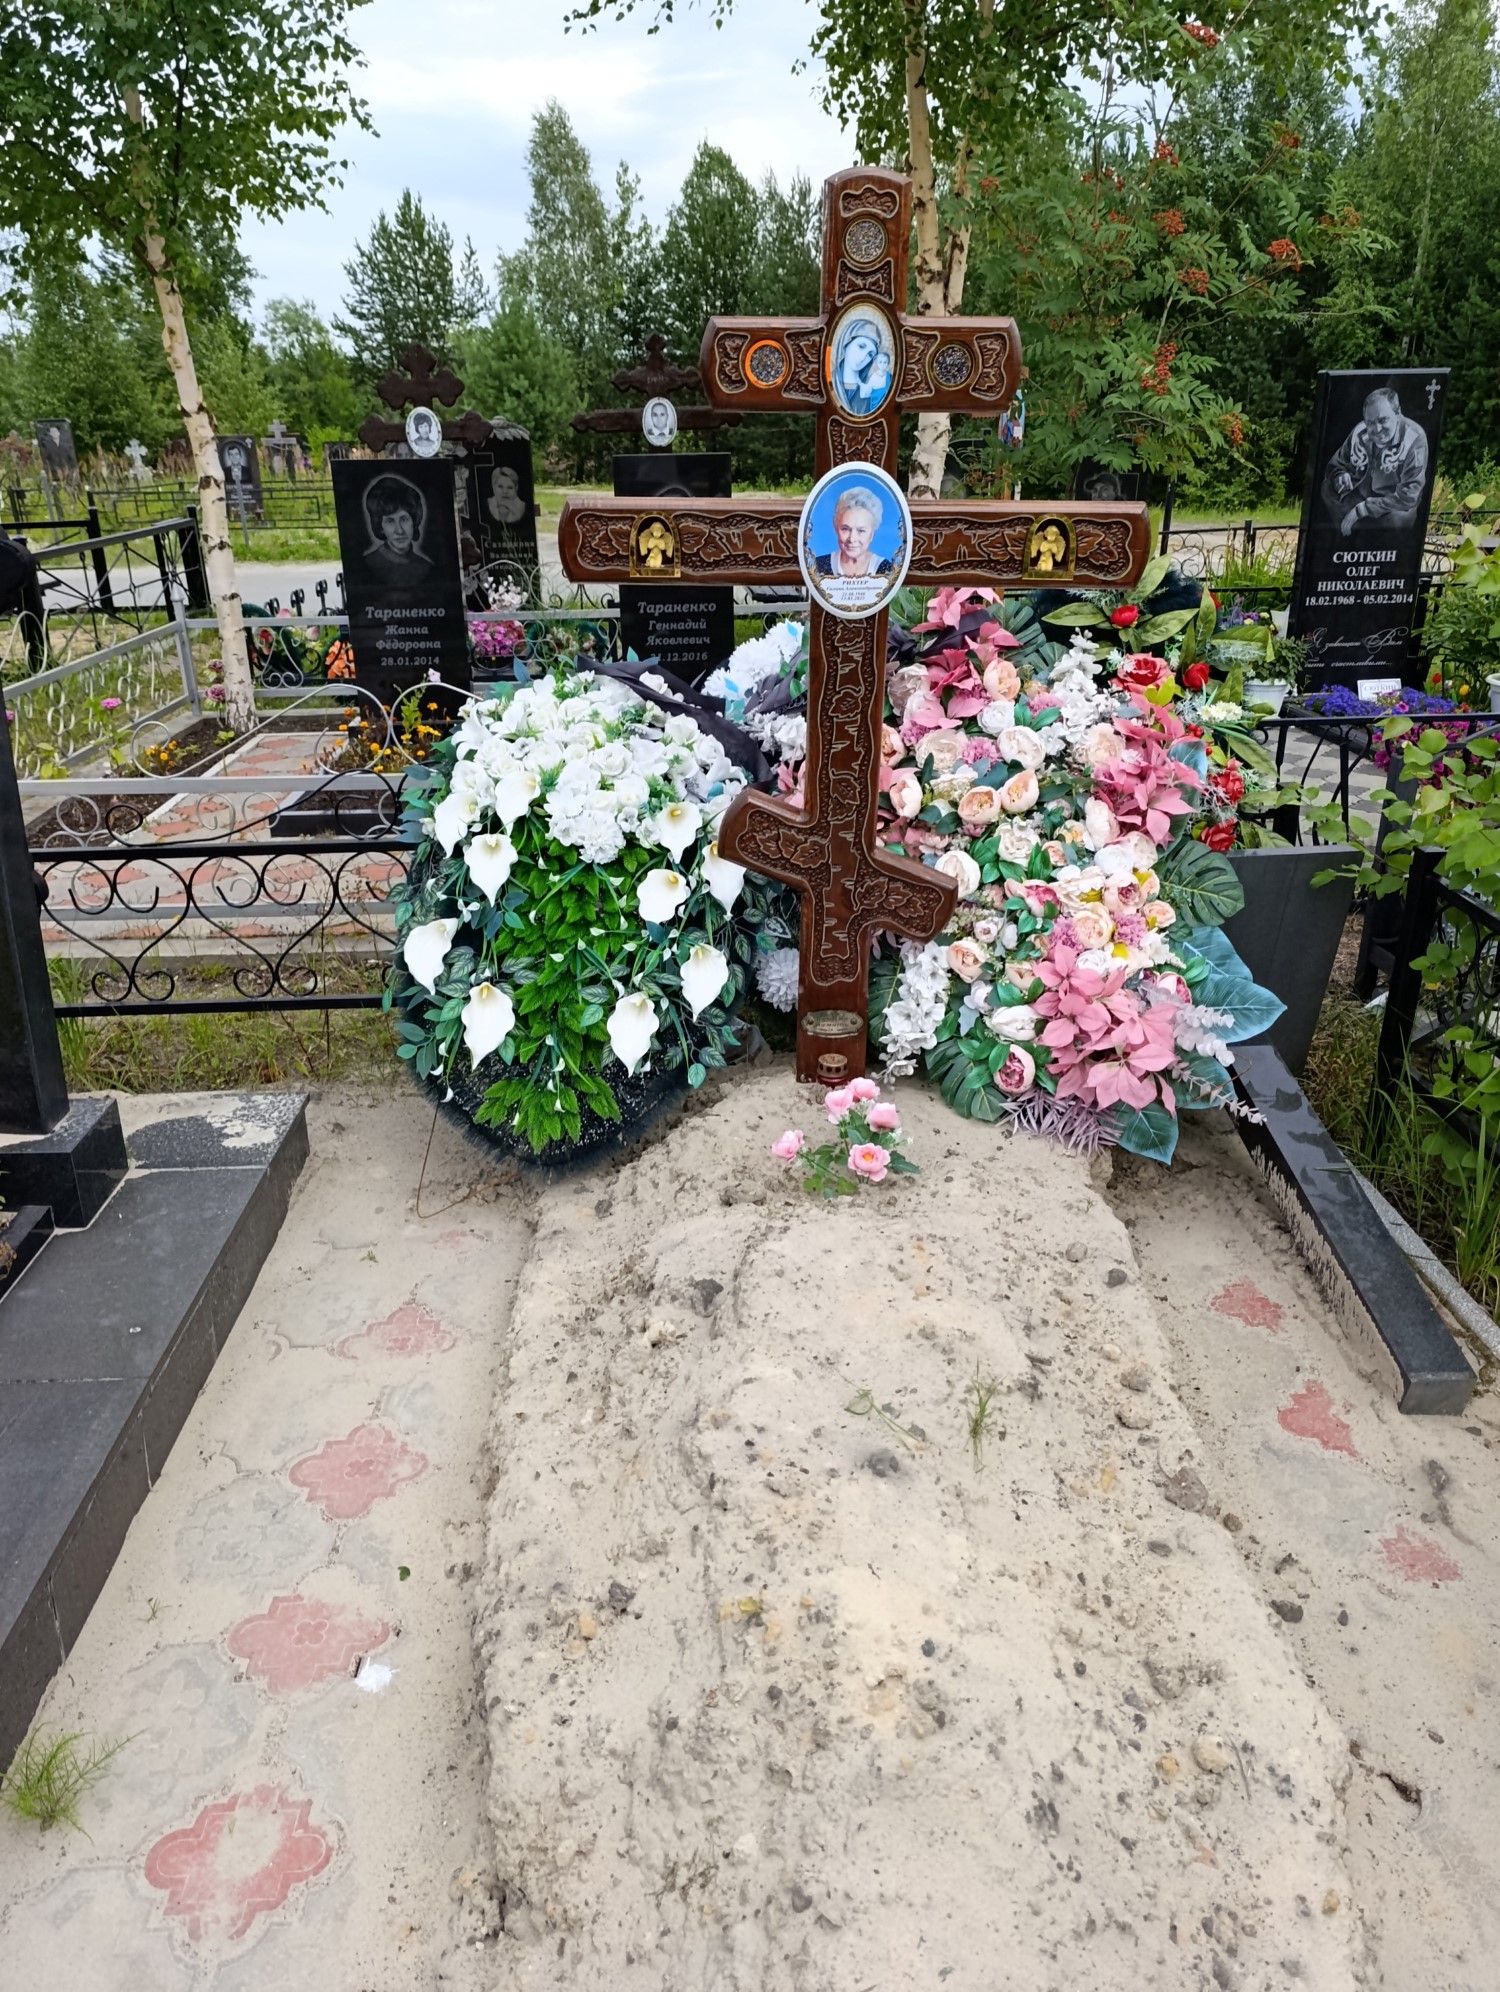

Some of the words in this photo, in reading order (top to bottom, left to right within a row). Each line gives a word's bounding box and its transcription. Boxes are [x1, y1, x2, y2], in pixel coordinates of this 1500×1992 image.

[1333, 550, 1398, 563] СЮТКИН
[1346, 566, 1381, 577] ОЛЕГ
[1317, 579, 1406, 592] НИКОЛАЕВИЧ
[1305, 595, 1355, 607] 18.02.1968
[1363, 593, 1414, 605] 05.02.2014
[365, 606, 446, 621] Тараненко
[638, 601, 717, 617] Тараненко
[385, 625, 430, 635] Жанна
[648, 618, 707, 631] Геннадий
[376, 638, 442, 652] Фёдоровна
[646, 635, 711, 646] Яковлевич
[381, 656, 441, 666] 28.01.2014
